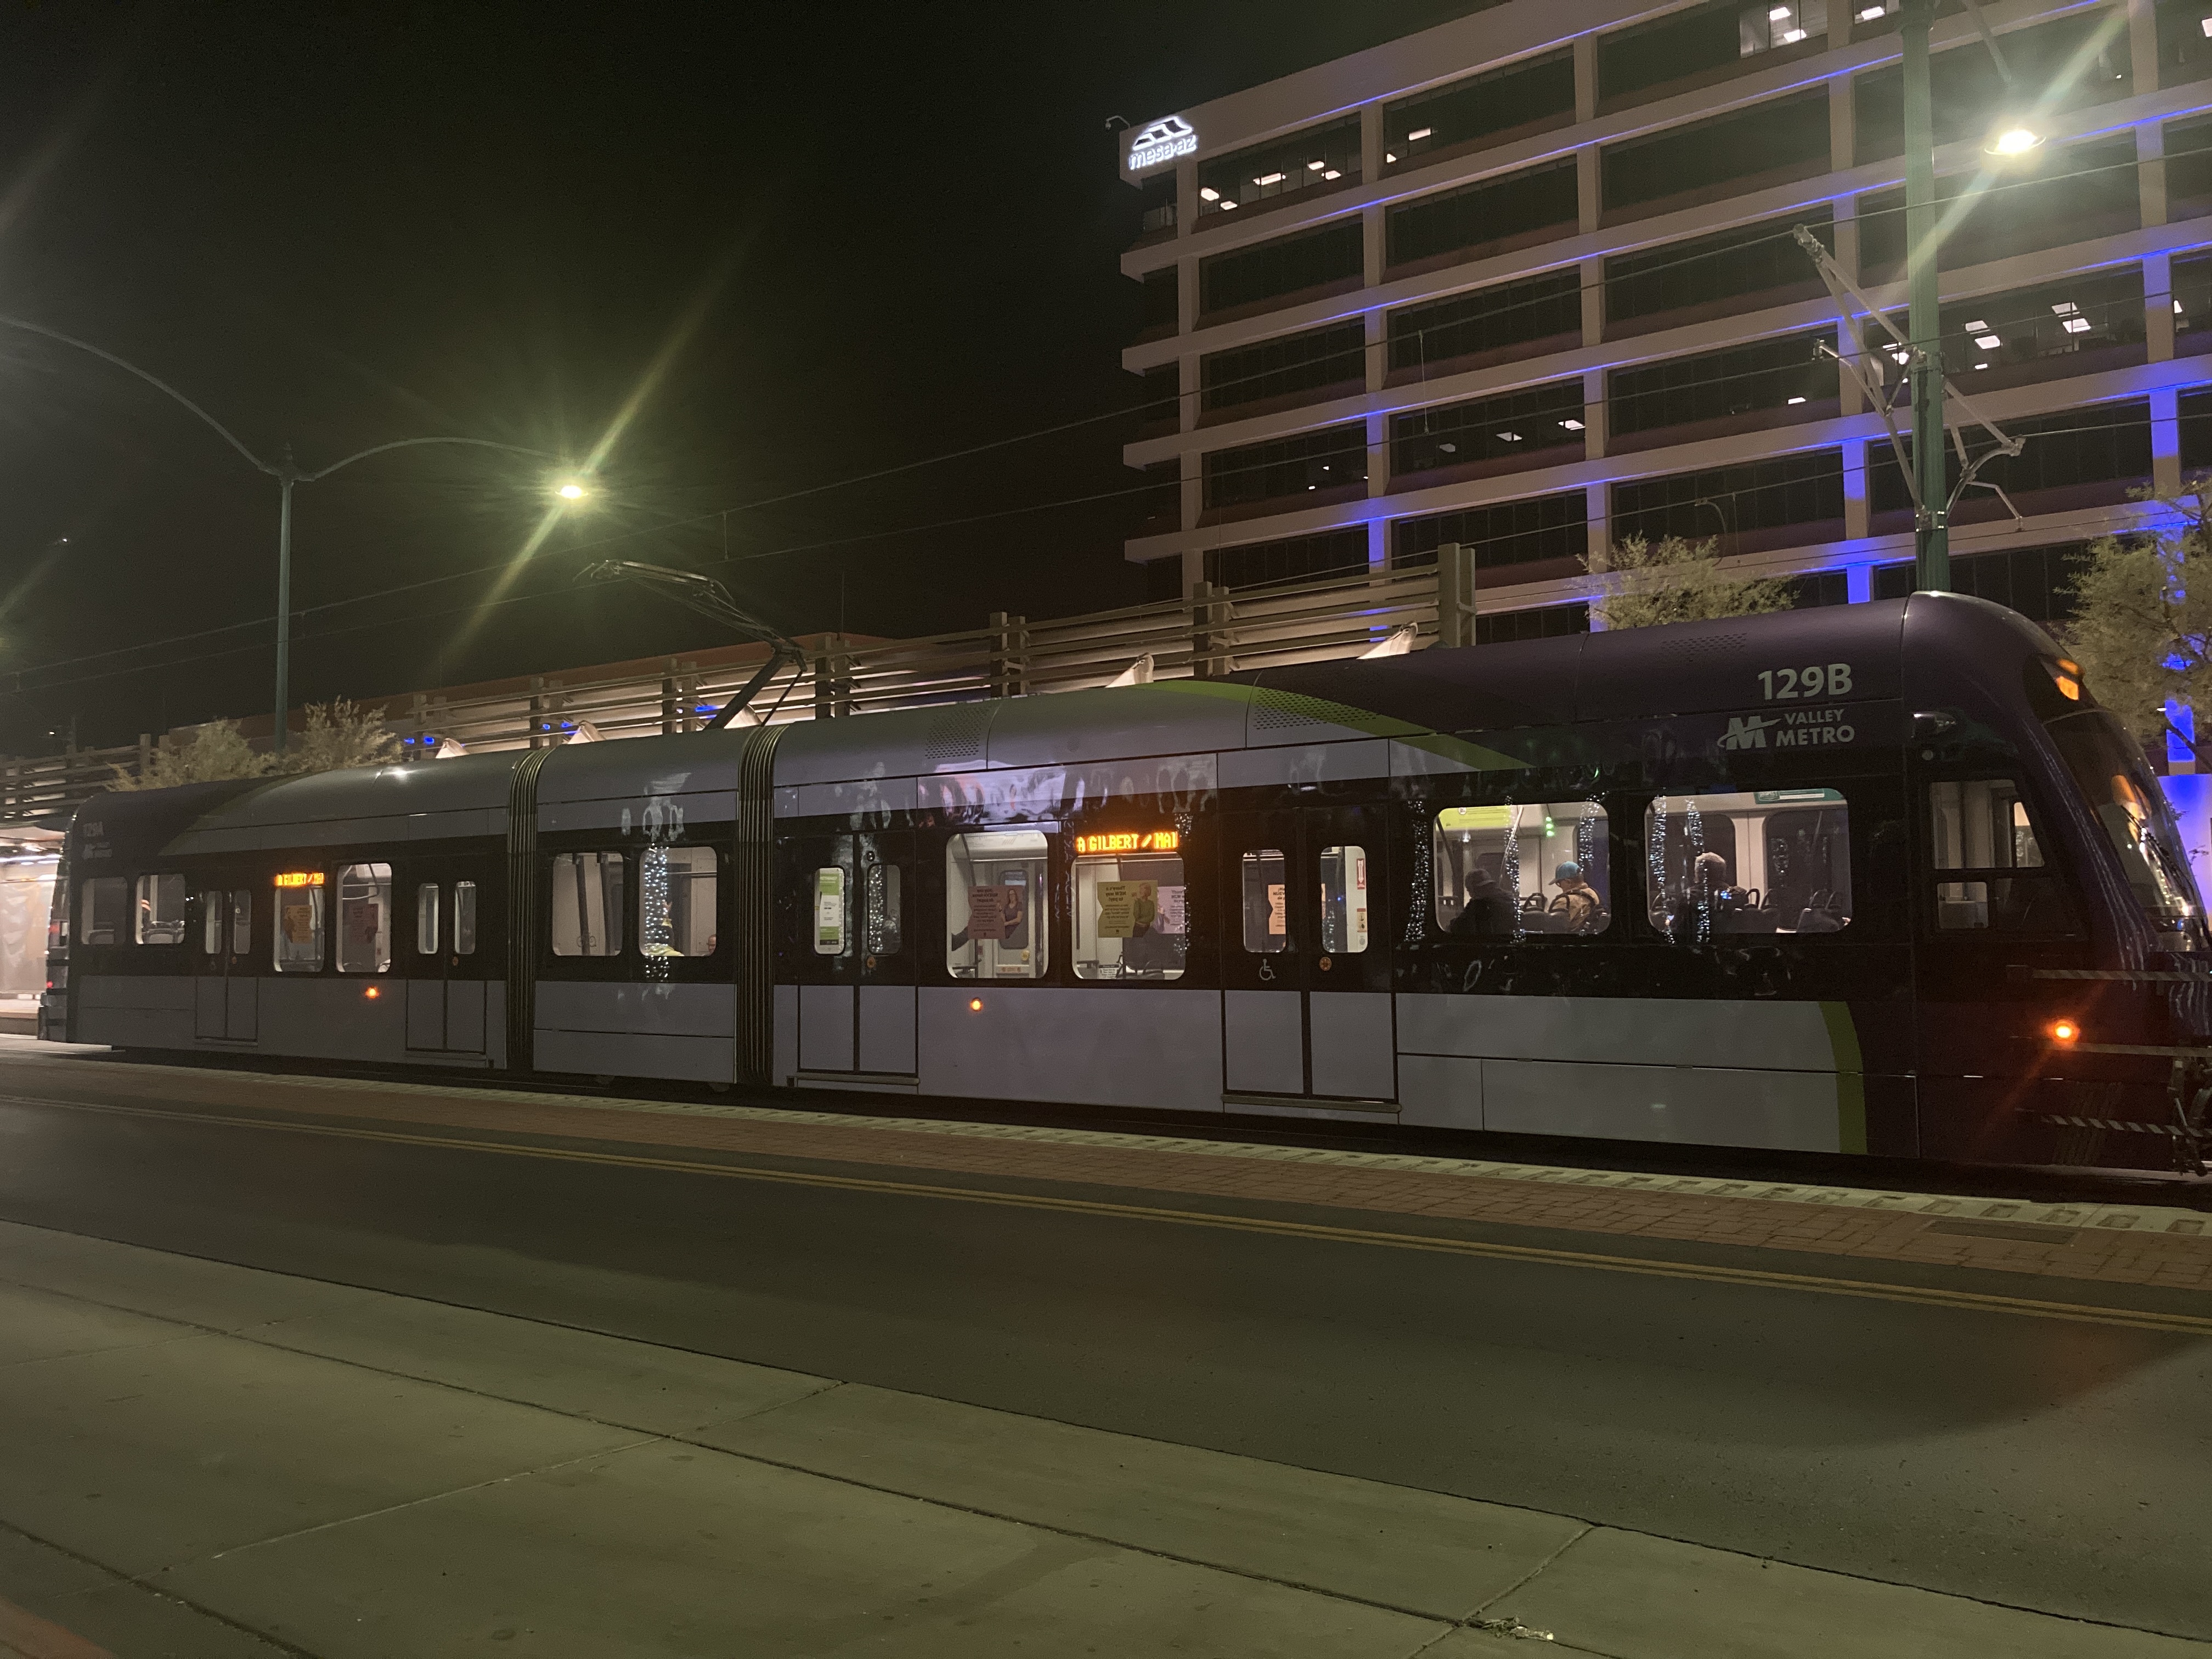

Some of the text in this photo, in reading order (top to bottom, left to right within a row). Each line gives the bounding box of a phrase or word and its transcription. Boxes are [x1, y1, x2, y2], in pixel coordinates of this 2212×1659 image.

[1757, 663, 1853, 700] 129B
[1785, 709, 1847, 725] VALLEY
[1776, 725, 1855, 747] METRO
[1077, 831, 1178, 851] A GILBERT / MAI
